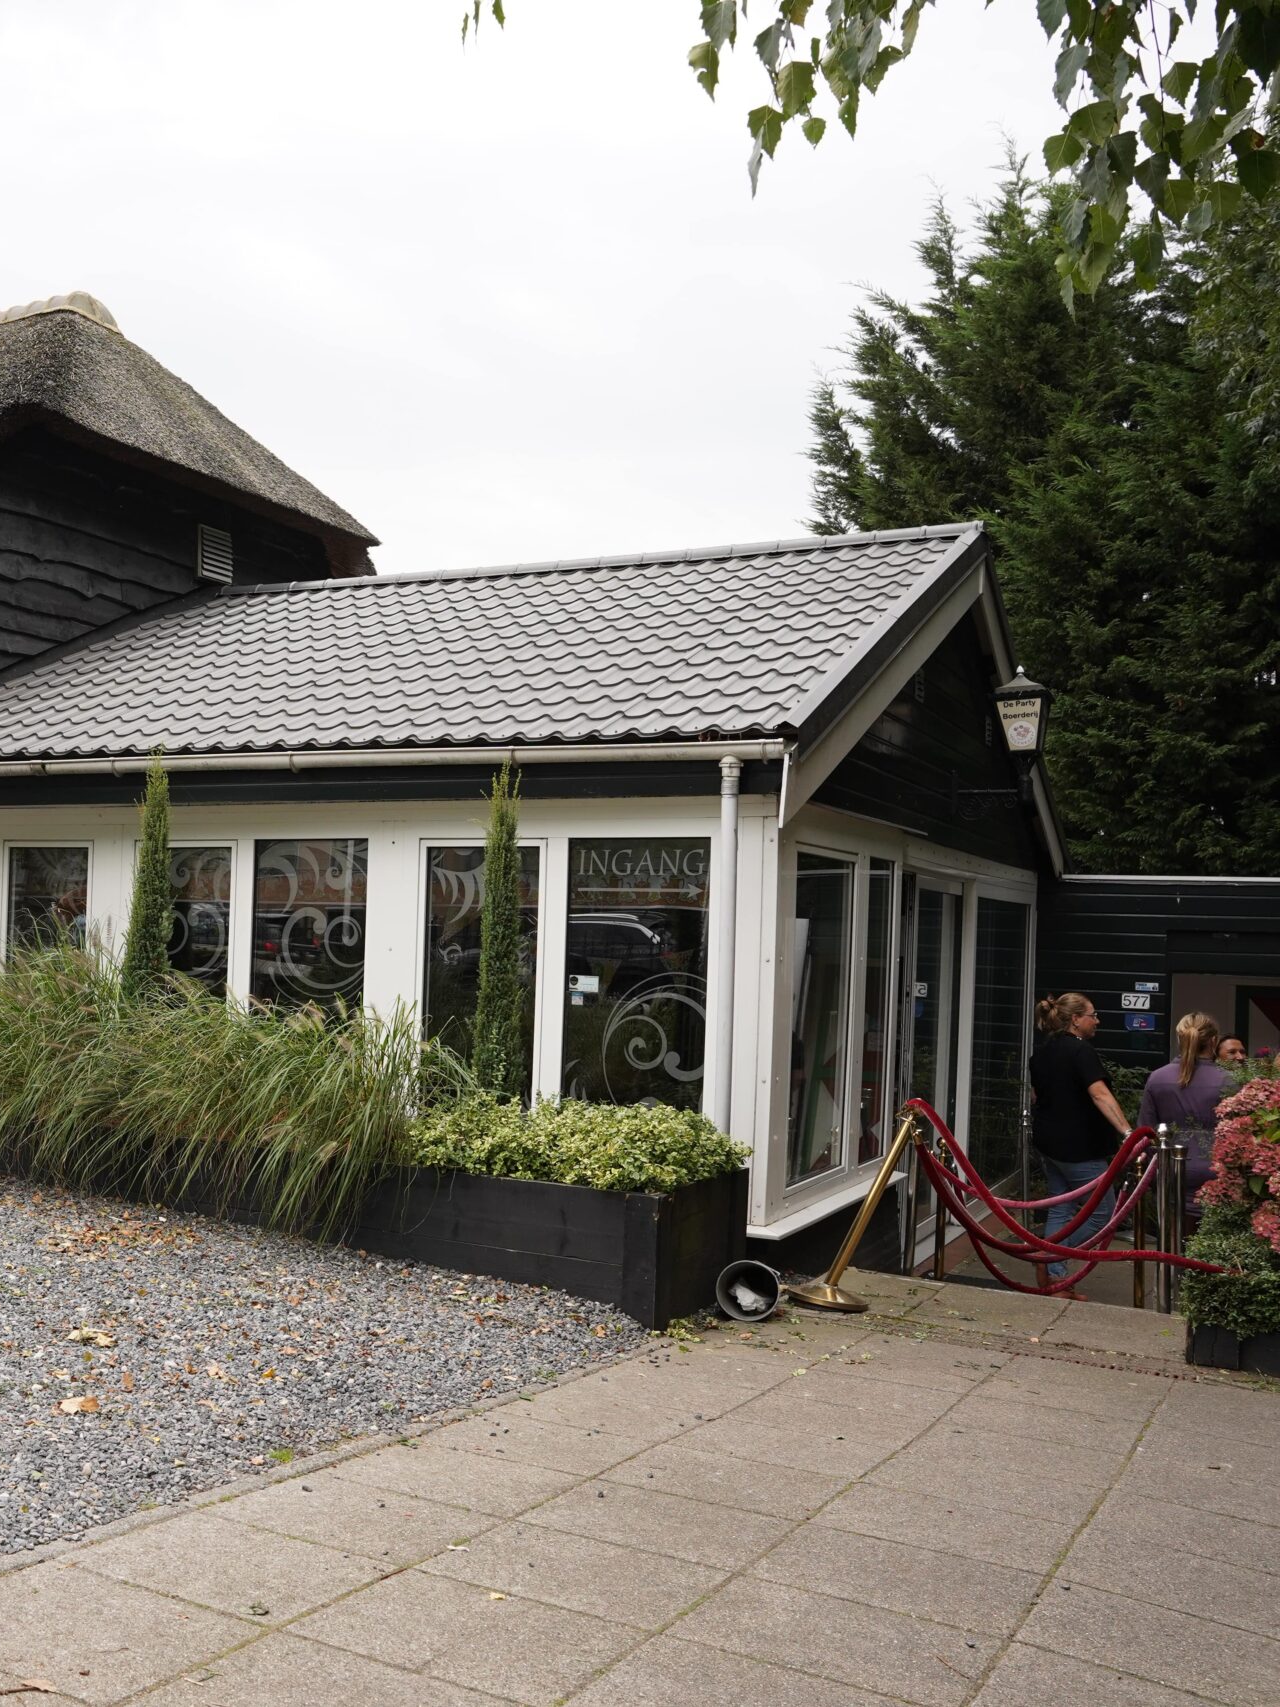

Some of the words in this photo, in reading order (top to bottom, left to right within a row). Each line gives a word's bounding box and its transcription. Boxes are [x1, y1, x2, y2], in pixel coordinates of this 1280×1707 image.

[1003, 711, 1038, 720] Boerderij
[579, 849, 705, 876] INGANG
[1123, 995, 1149, 1007] 577
